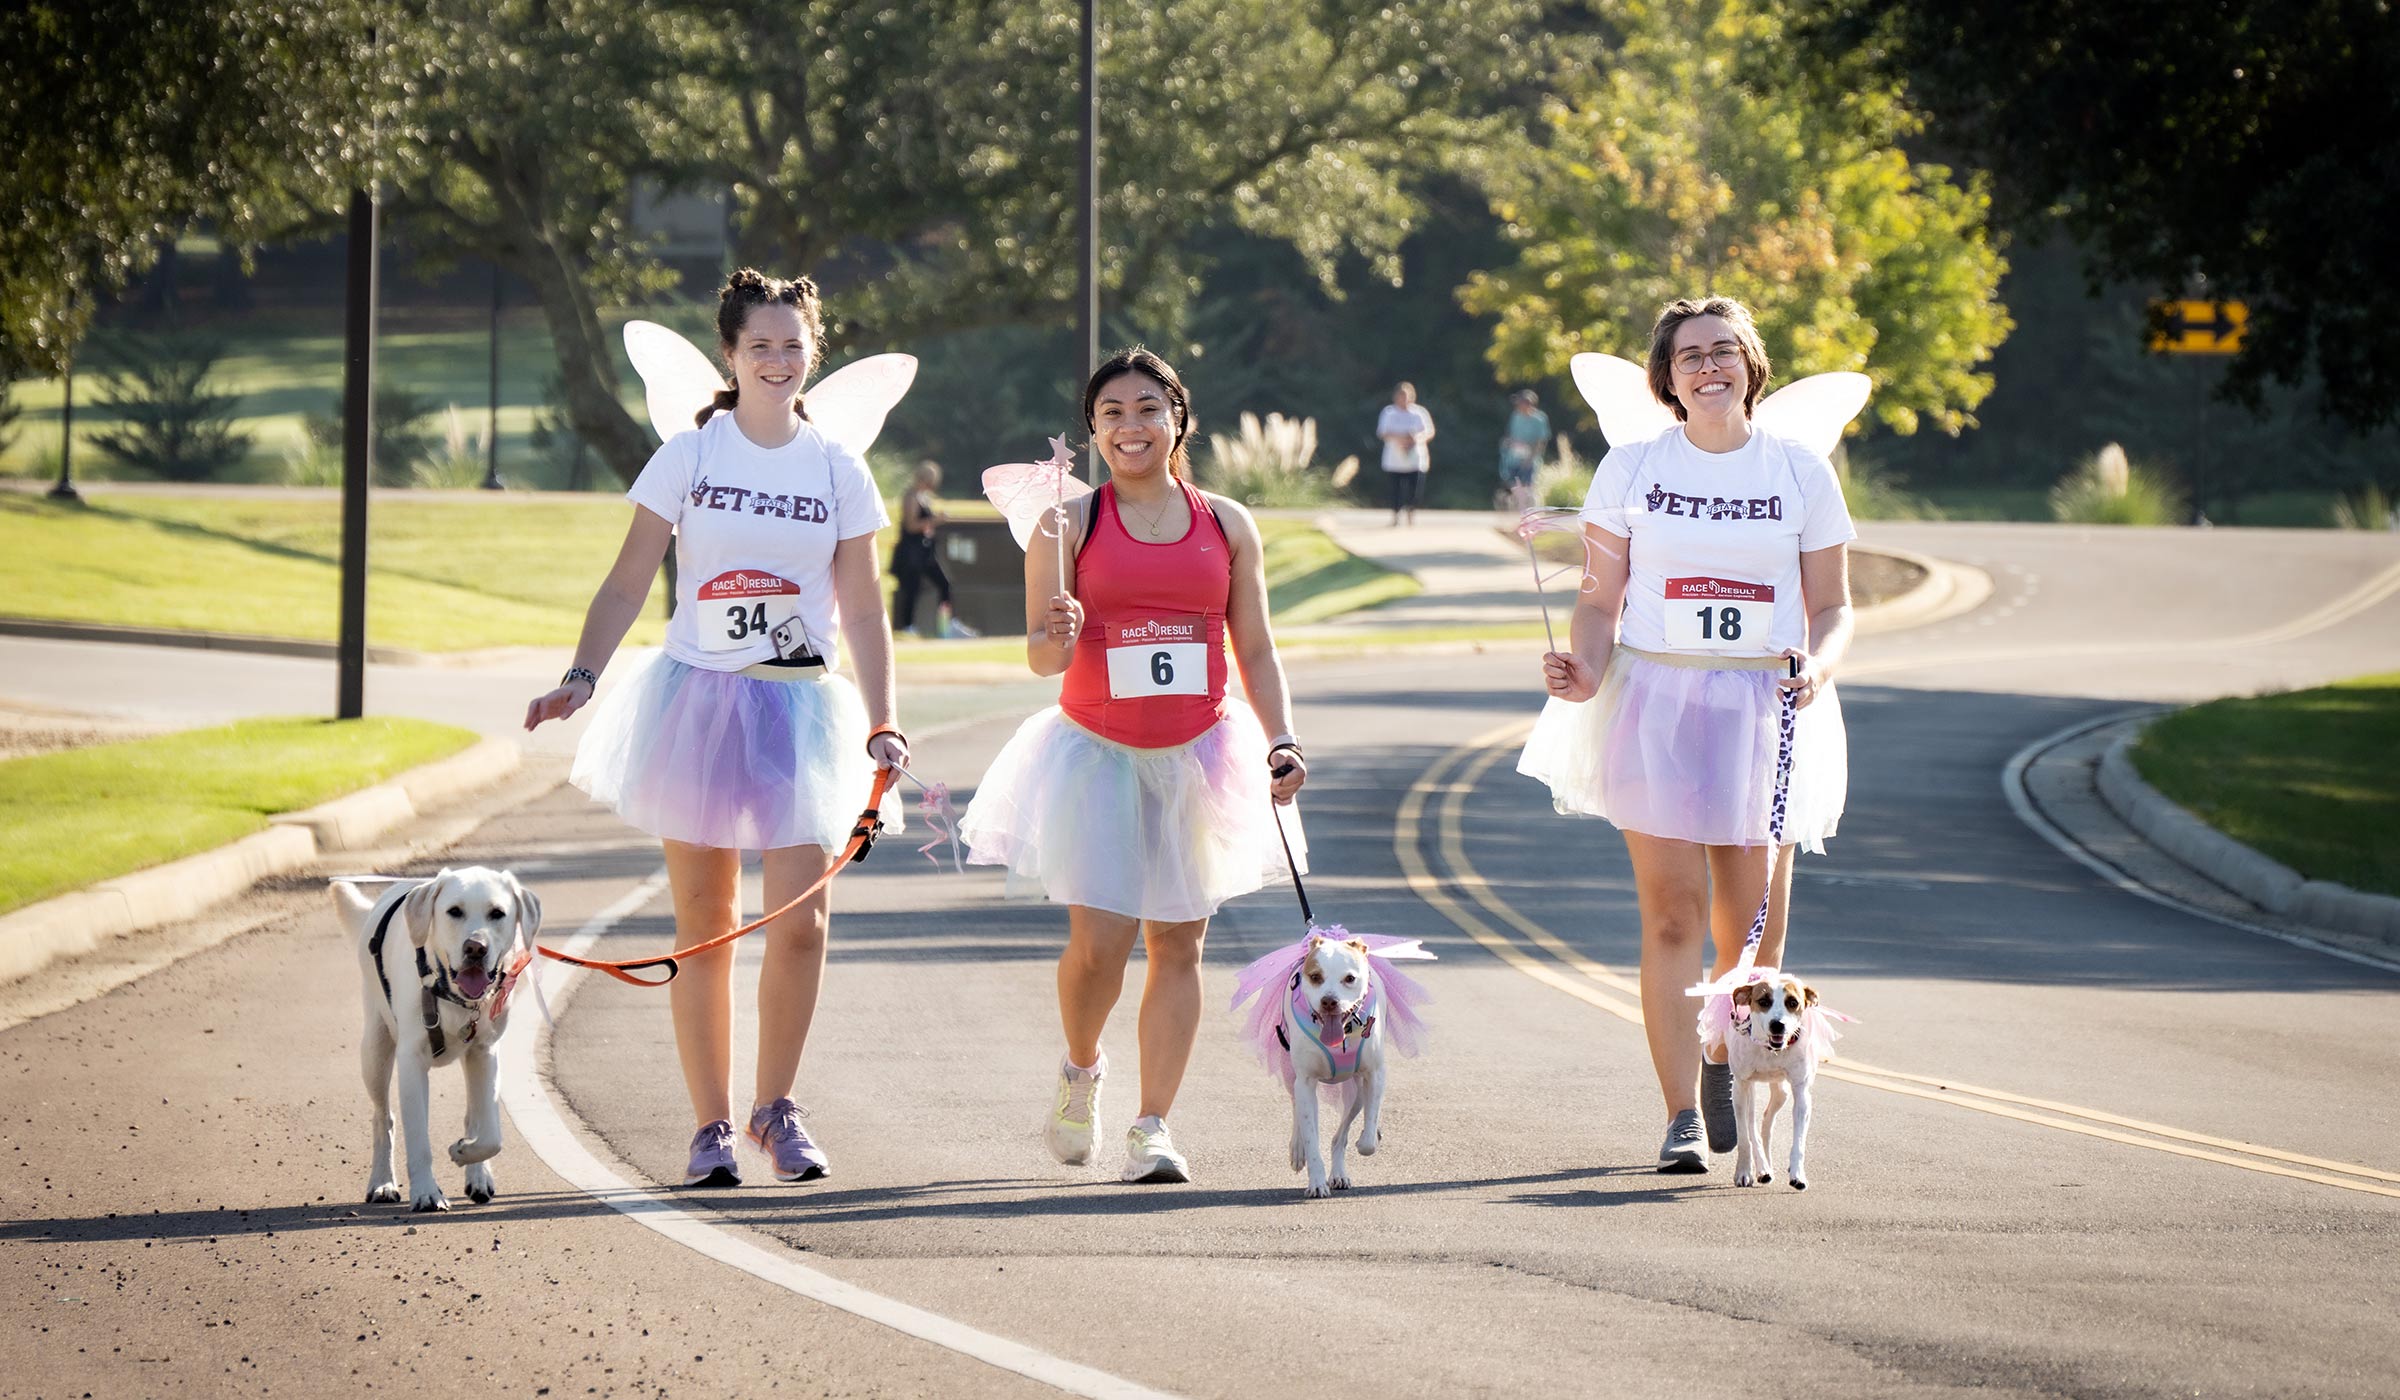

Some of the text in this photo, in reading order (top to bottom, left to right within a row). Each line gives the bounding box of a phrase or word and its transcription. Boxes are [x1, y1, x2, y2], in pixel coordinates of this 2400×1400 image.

[755, 498, 786, 510] STATE
[1713, 503, 1741, 513] STATE
[711, 578, 782, 591] RACE RESULT
[1682, 584, 1757, 595] RACE RESULT
[726, 602, 768, 640] 34
[1696, 606, 1742, 641] 18
[1121, 625, 1194, 639] RACE RESULT
[1150, 651, 1174, 686] 6
